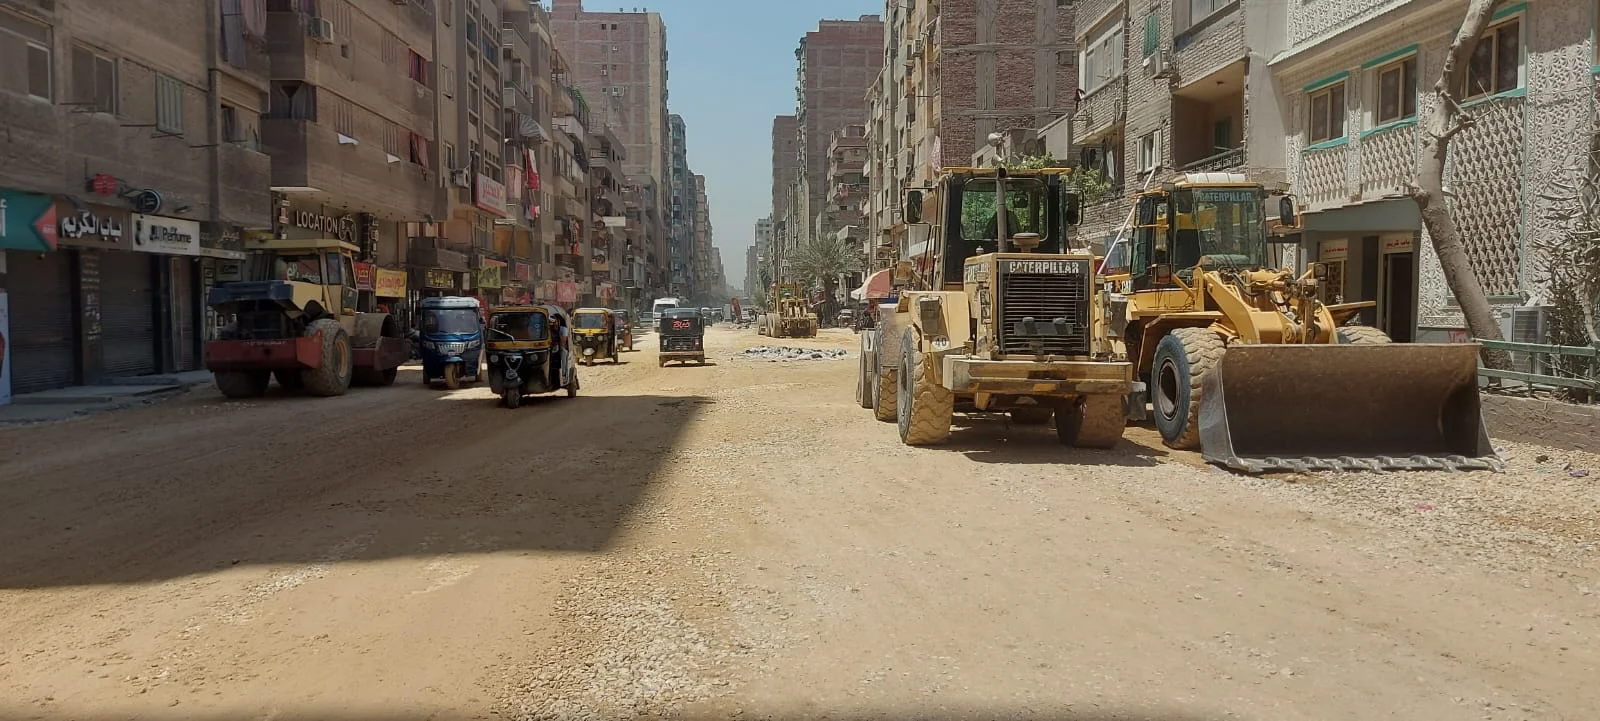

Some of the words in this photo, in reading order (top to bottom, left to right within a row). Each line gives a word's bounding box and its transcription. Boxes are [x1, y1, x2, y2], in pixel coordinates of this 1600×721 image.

[1200, 191, 1252, 202] CATERPILLAR
[62, 211, 99, 239] الكريم
[100, 215, 122, 241] باب
[296, 209, 338, 234] LOCATION
[1007, 261, 1080, 274] CATERPILLAR
